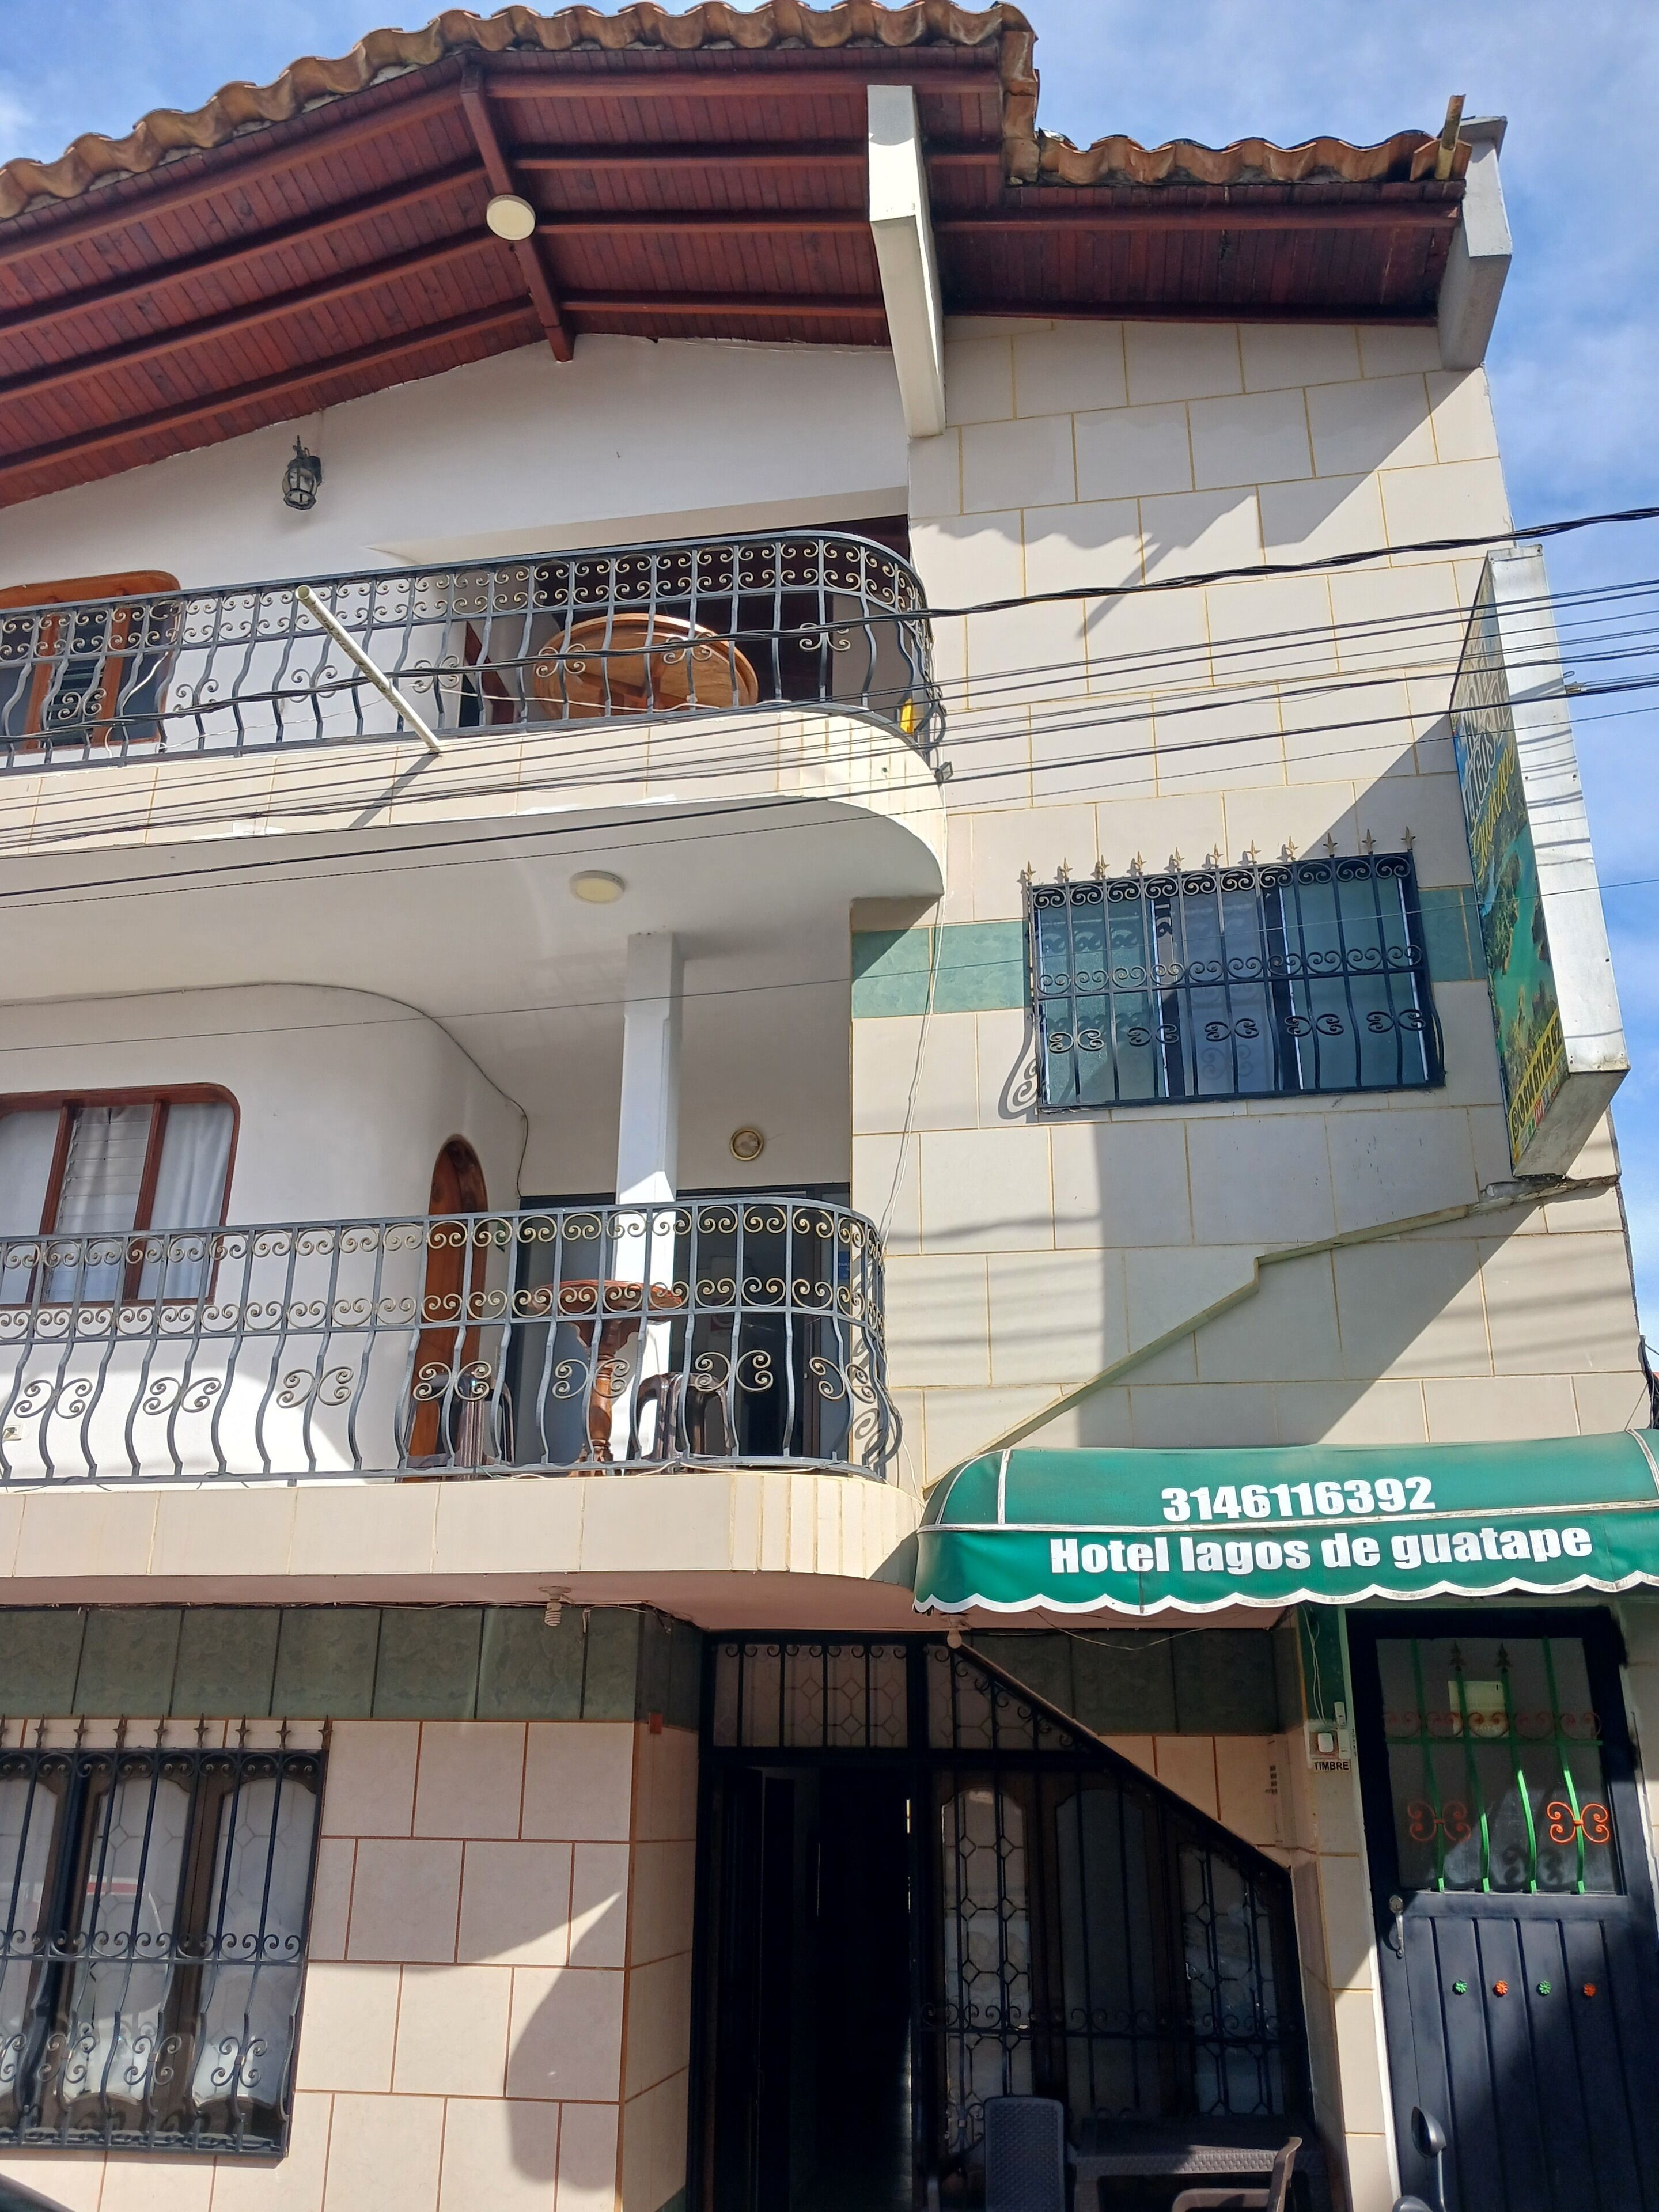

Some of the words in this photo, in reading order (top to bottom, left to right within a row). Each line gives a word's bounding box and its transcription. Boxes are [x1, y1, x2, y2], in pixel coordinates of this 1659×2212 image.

[1463, 710, 1496, 838] LAGOS
[1161, 1476, 1436, 1522] 3146116392
[1050, 1537, 1170, 1573] Hotel
[1180, 1536, 1312, 1575] lagos
[1320, 1533, 1381, 1568] de
[1391, 1527, 1593, 1569] guatape
[1313, 1762, 1349, 1770] TIMBRE
